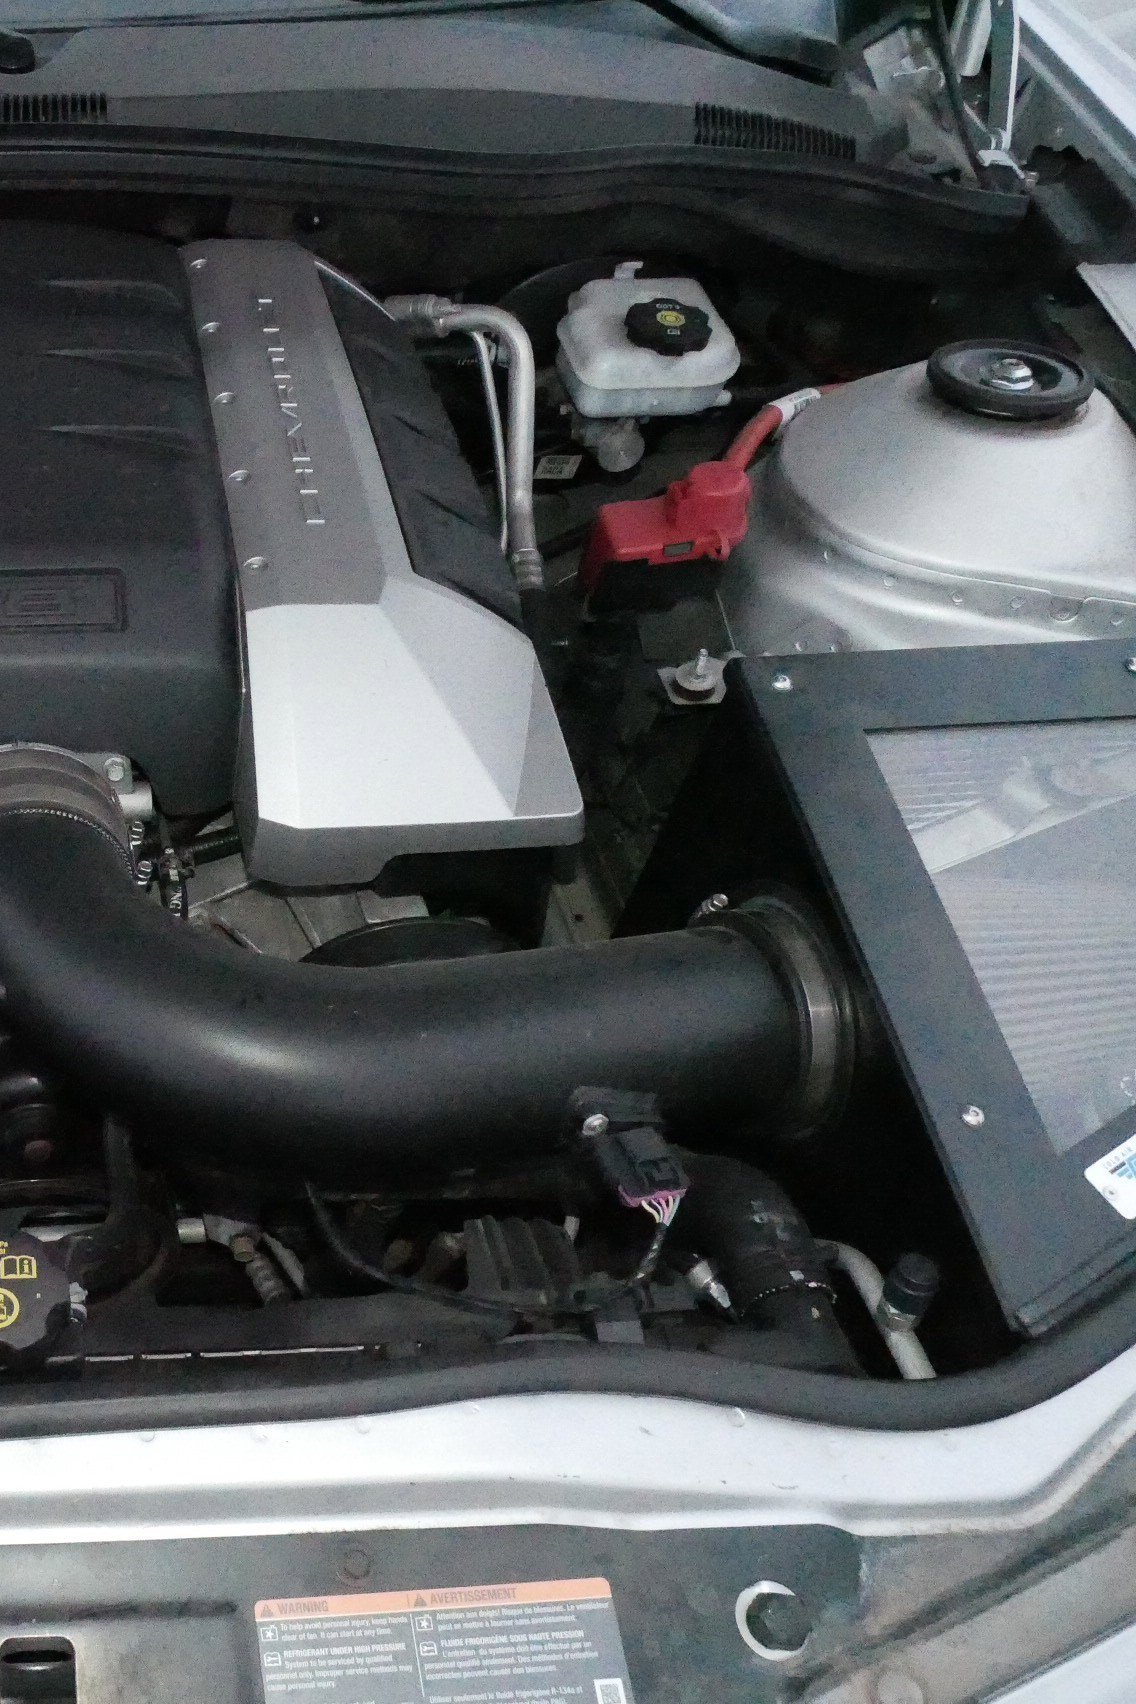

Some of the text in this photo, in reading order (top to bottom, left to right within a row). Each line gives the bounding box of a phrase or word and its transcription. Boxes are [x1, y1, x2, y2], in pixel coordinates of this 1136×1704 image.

[431, 1588, 517, 1604] AVERTISSEMENT
[277, 1601, 329, 1614] WARNING
[441, 1638, 464, 1647] FLUIDE
[551, 1630, 584, 1639] PRESSION
[284, 1643, 406, 1658] REFRIGERANT UNDER HIGH PRESSURE
